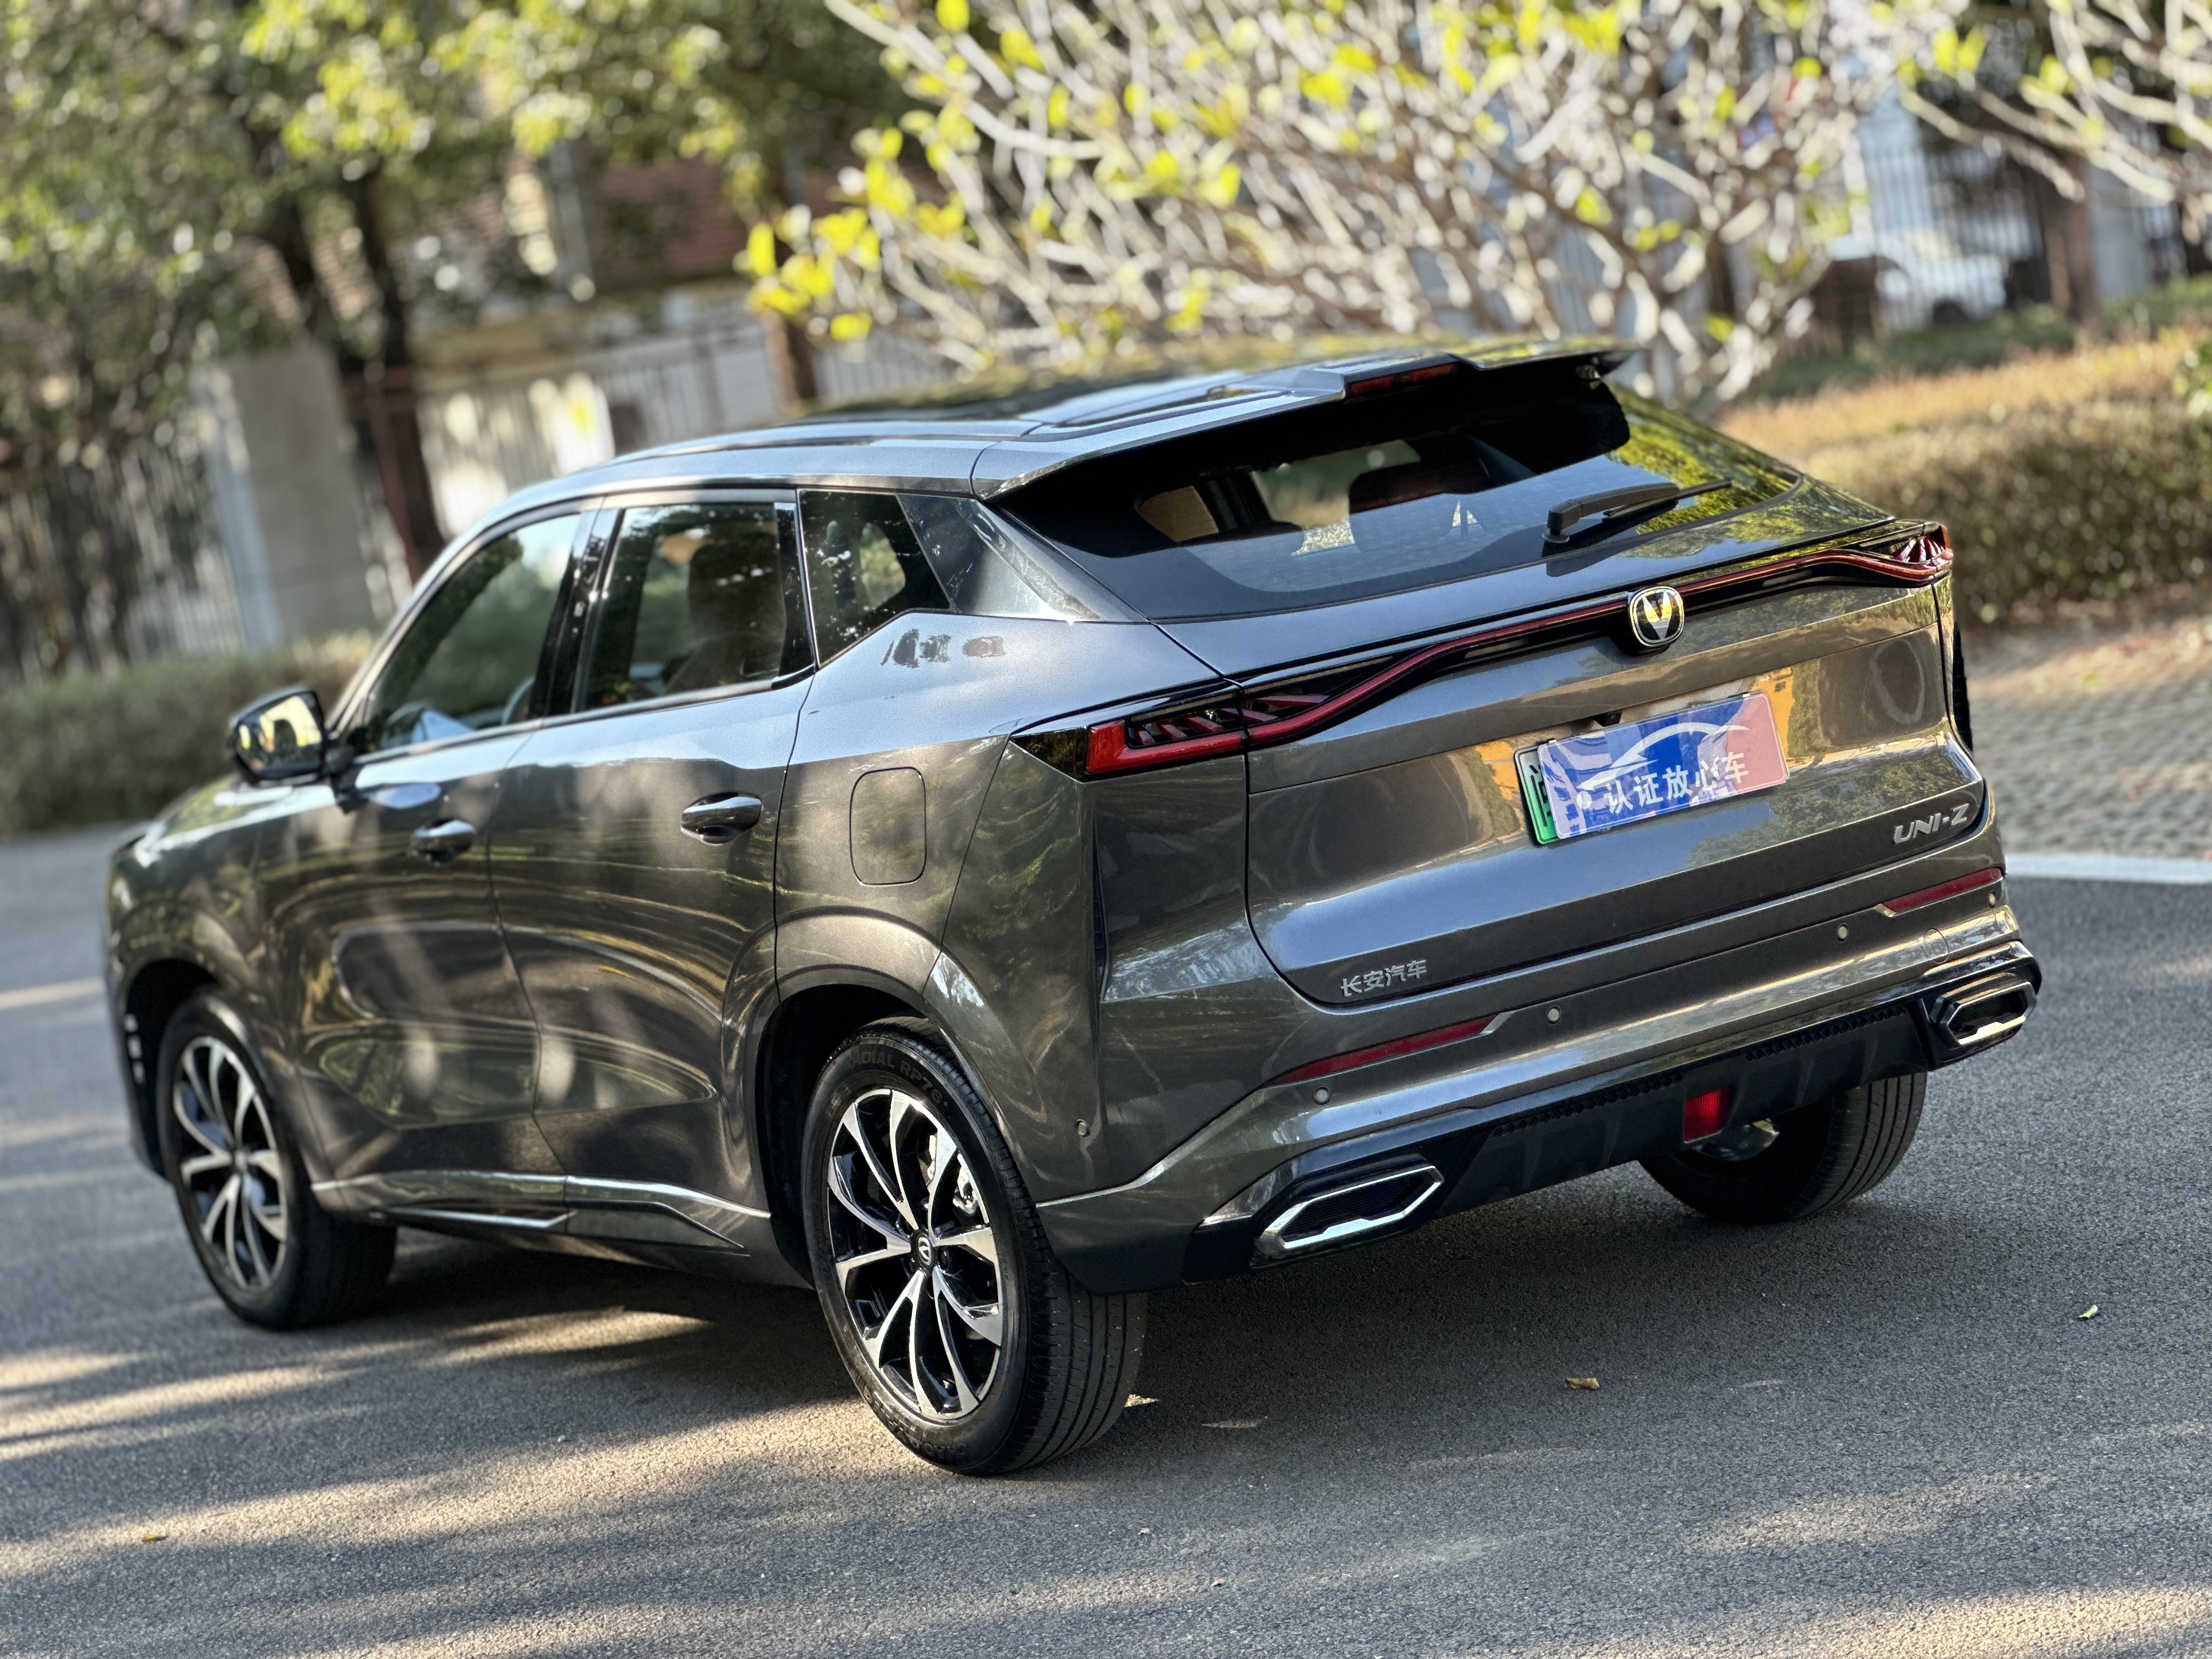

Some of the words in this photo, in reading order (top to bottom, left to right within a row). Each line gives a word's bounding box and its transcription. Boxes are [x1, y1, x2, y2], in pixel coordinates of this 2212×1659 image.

[1604, 752, 1749, 814] 认证放心车
[1894, 803, 1970, 844] UNI-Z
[1340, 960, 1427, 997] 长安汽车
